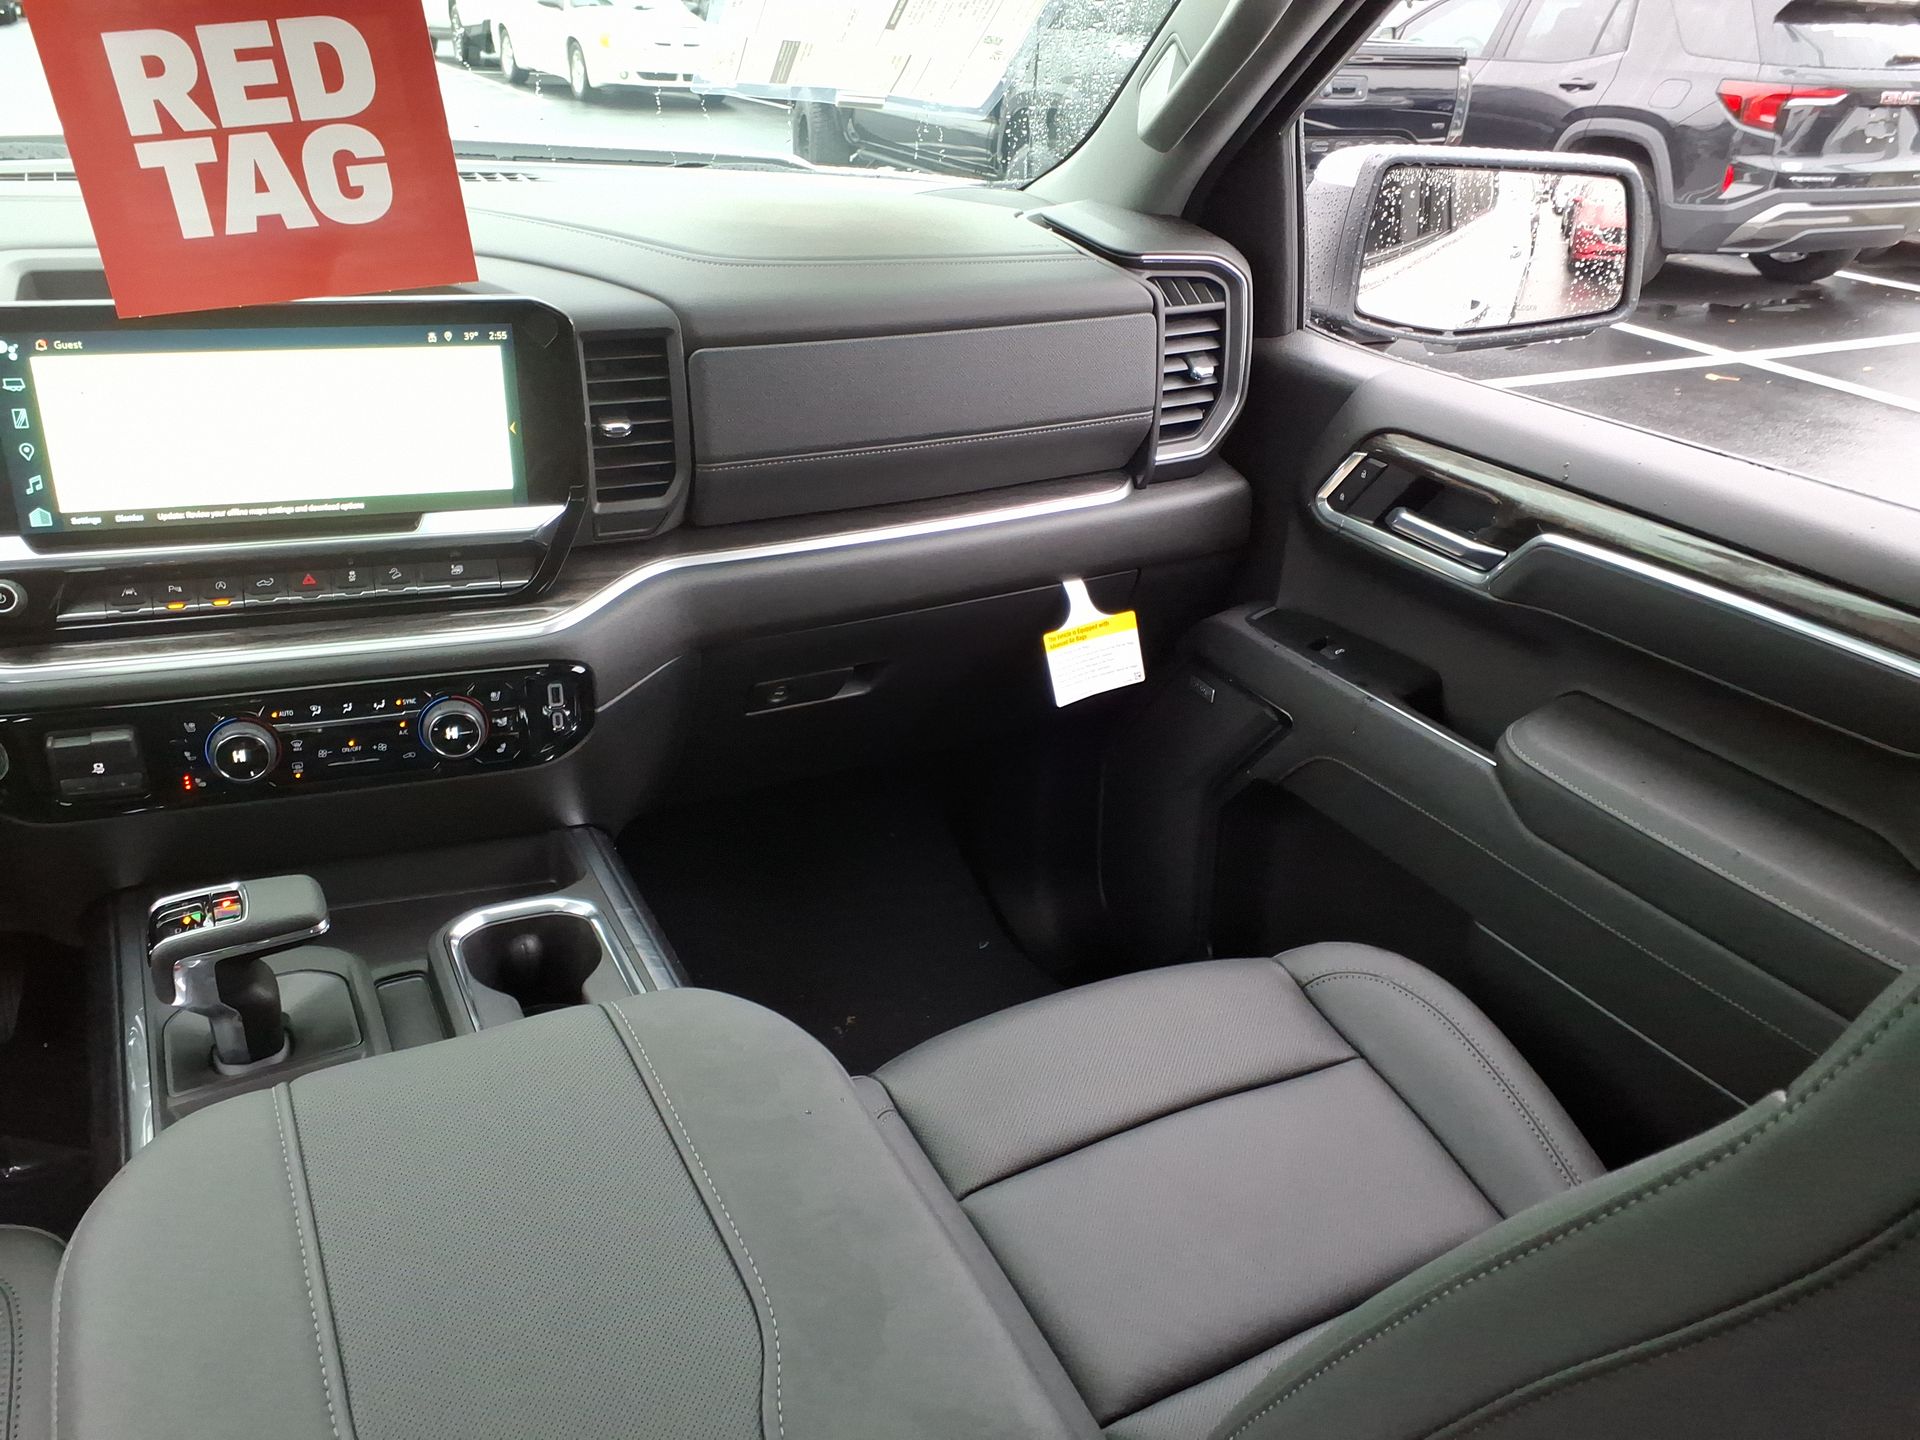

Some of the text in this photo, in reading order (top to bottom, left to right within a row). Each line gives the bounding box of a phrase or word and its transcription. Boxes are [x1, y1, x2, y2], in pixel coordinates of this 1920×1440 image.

[101, 15, 377, 137] RED
[133, 123, 394, 240] TAG
[463, 331, 479, 341] 39°
[488, 331, 508, 341] 2:55
[53, 340, 83, 350] Guest
[402, 697, 417, 705] SYNC
[341, 746, 362, 754] ON/OFF
[232, 749, 246, 763] HI
